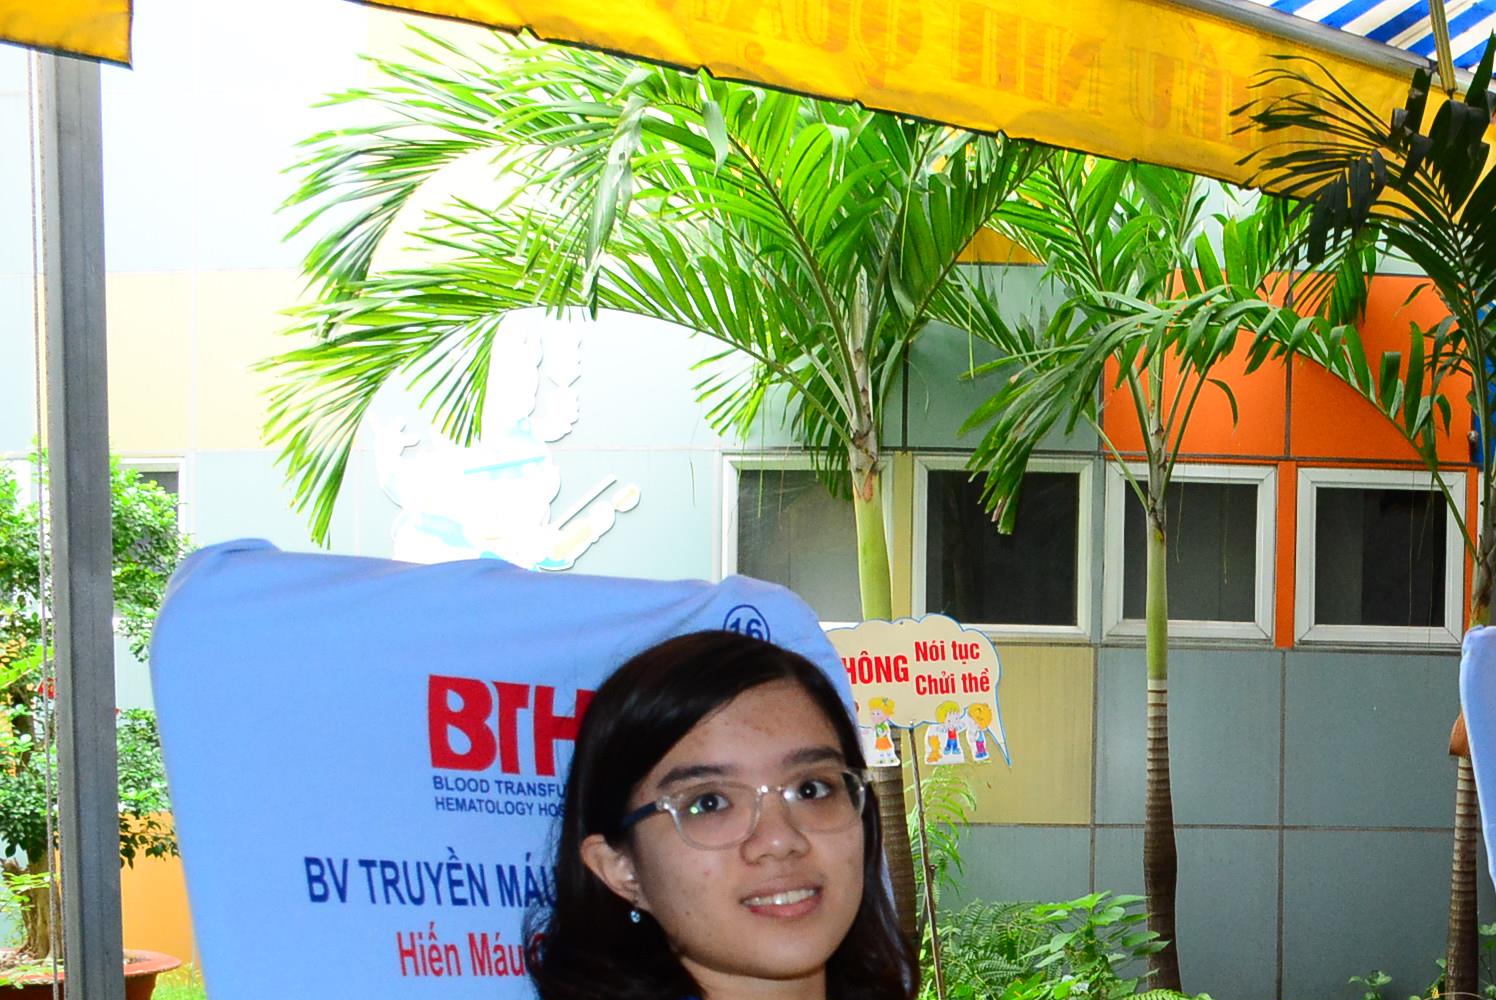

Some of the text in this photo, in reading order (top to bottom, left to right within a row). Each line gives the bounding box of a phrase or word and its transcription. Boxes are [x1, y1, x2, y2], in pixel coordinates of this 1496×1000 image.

[730, 617, 764, 641] 16
[915, 640, 980, 665] Nói tục
[841, 650, 910, 685] HÔNG
[915, 668, 990, 696] Chửi thề
[428, 674, 598, 777] BTH
[433, 775, 566, 798] BLOOD TRANSFU
[434, 796, 534, 817] HEMATOLOGY
[304, 856, 348, 903] BV
[358, 846, 490, 907] TRUYỀN
[396, 921, 462, 977] Hiến
[467, 932, 526, 977] Máu
